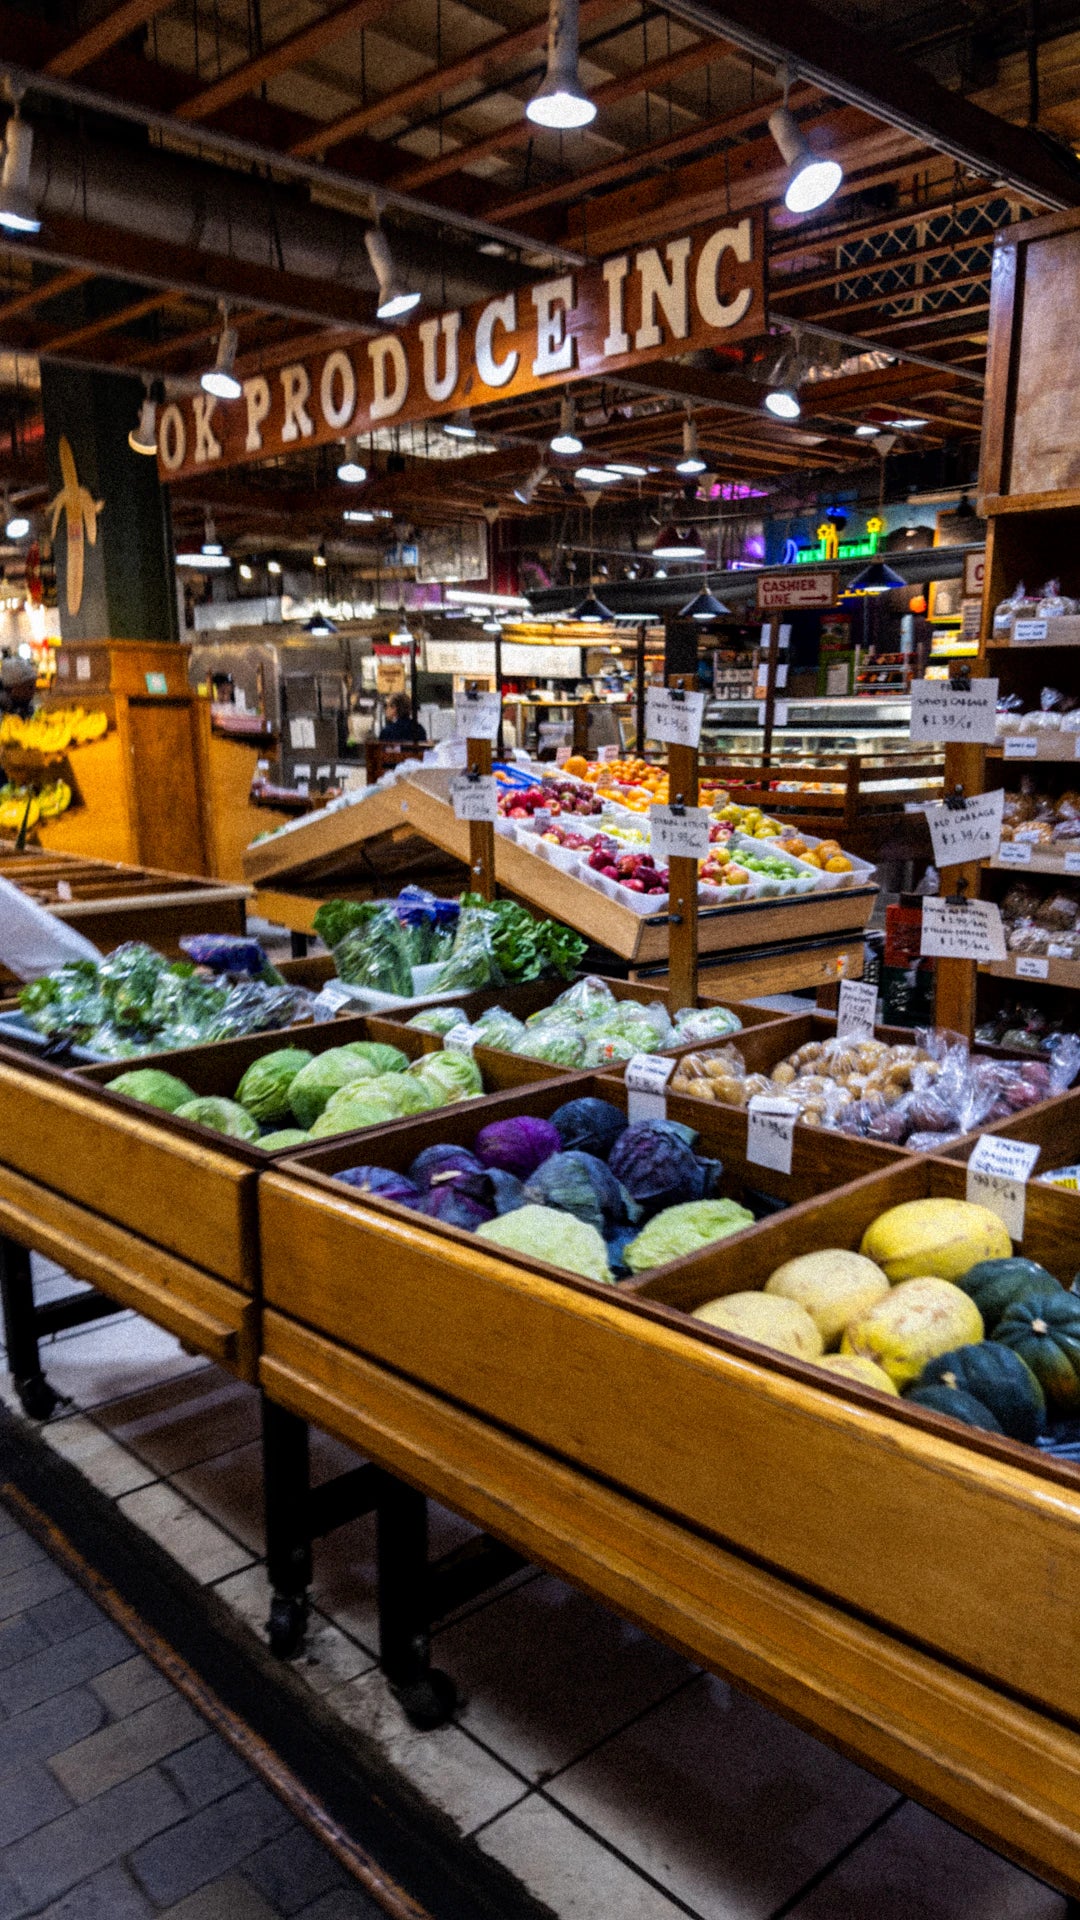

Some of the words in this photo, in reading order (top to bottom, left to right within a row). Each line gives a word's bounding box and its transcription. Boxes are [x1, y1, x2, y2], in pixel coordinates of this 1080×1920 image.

[159, 396, 222, 471] OK
[244, 276, 578, 452] PRODUCE
[602, 217, 756, 358] INC
[762, 579, 817, 592] CASHIER
[763, 594, 791, 605] LINE
